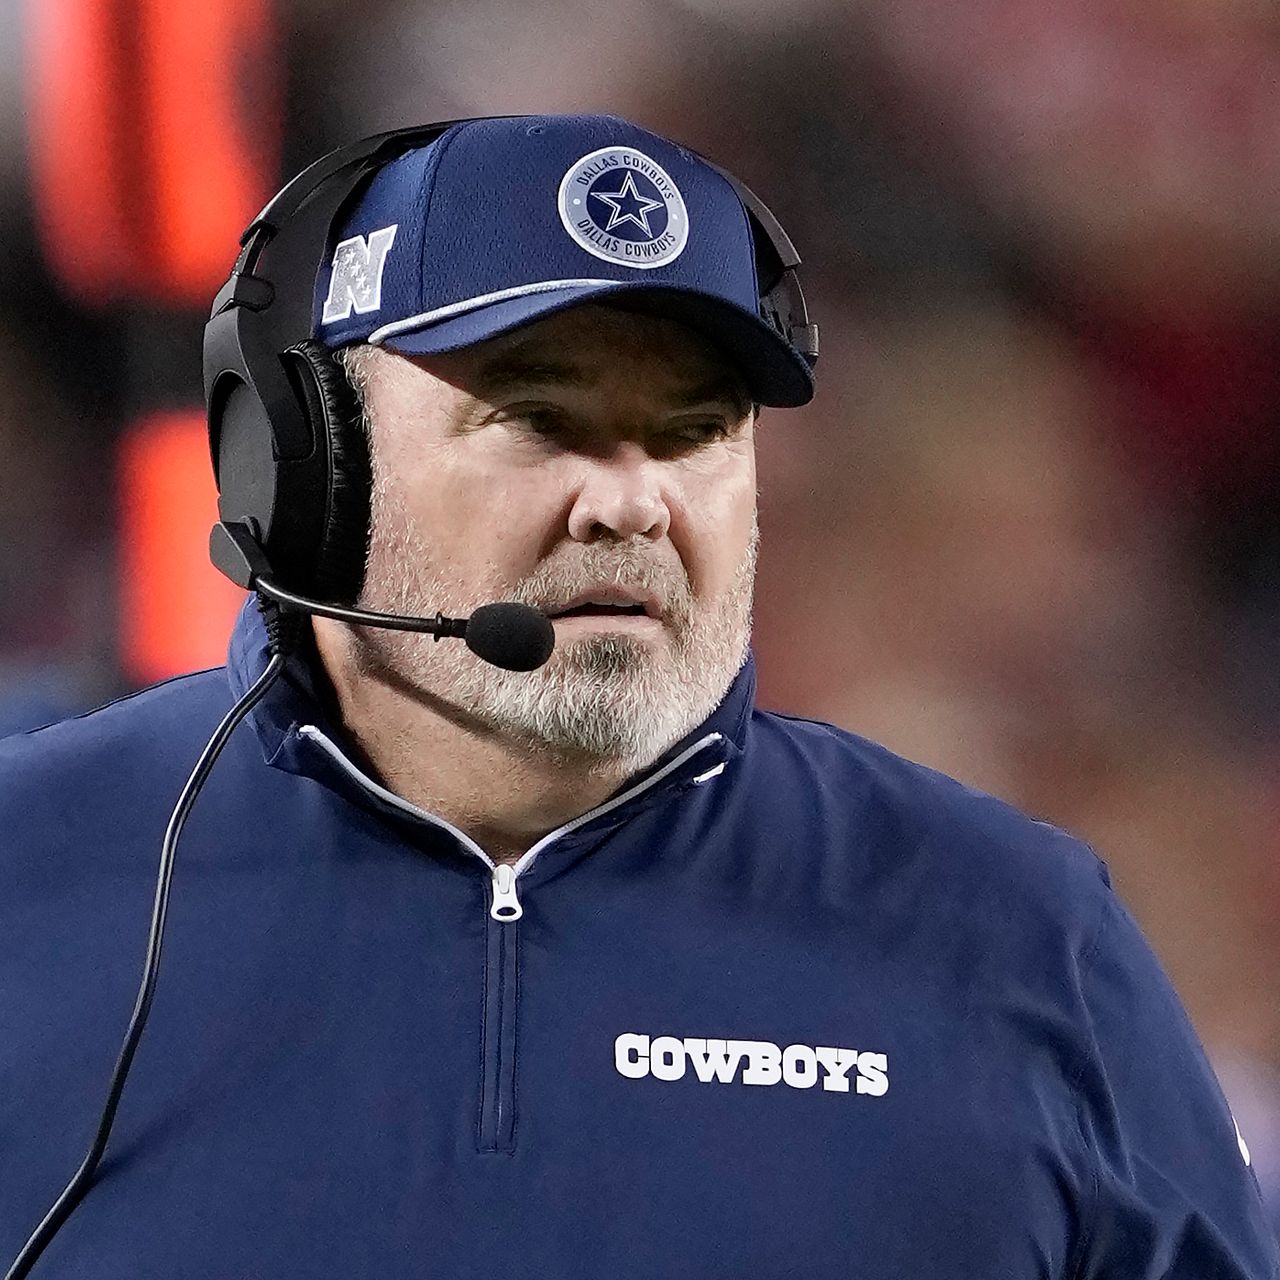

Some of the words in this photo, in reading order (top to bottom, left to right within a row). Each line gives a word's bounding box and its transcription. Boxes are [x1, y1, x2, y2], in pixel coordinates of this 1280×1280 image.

[576, 155, 619, 186] DALLAS
[623, 155, 675, 200] COWBOYS
[577, 218, 620, 252] DALLAS
[625, 231, 676, 258] COWBOYS
[321, 224, 398, 326] N
[614, 1032, 889, 1097] COWBOYS
